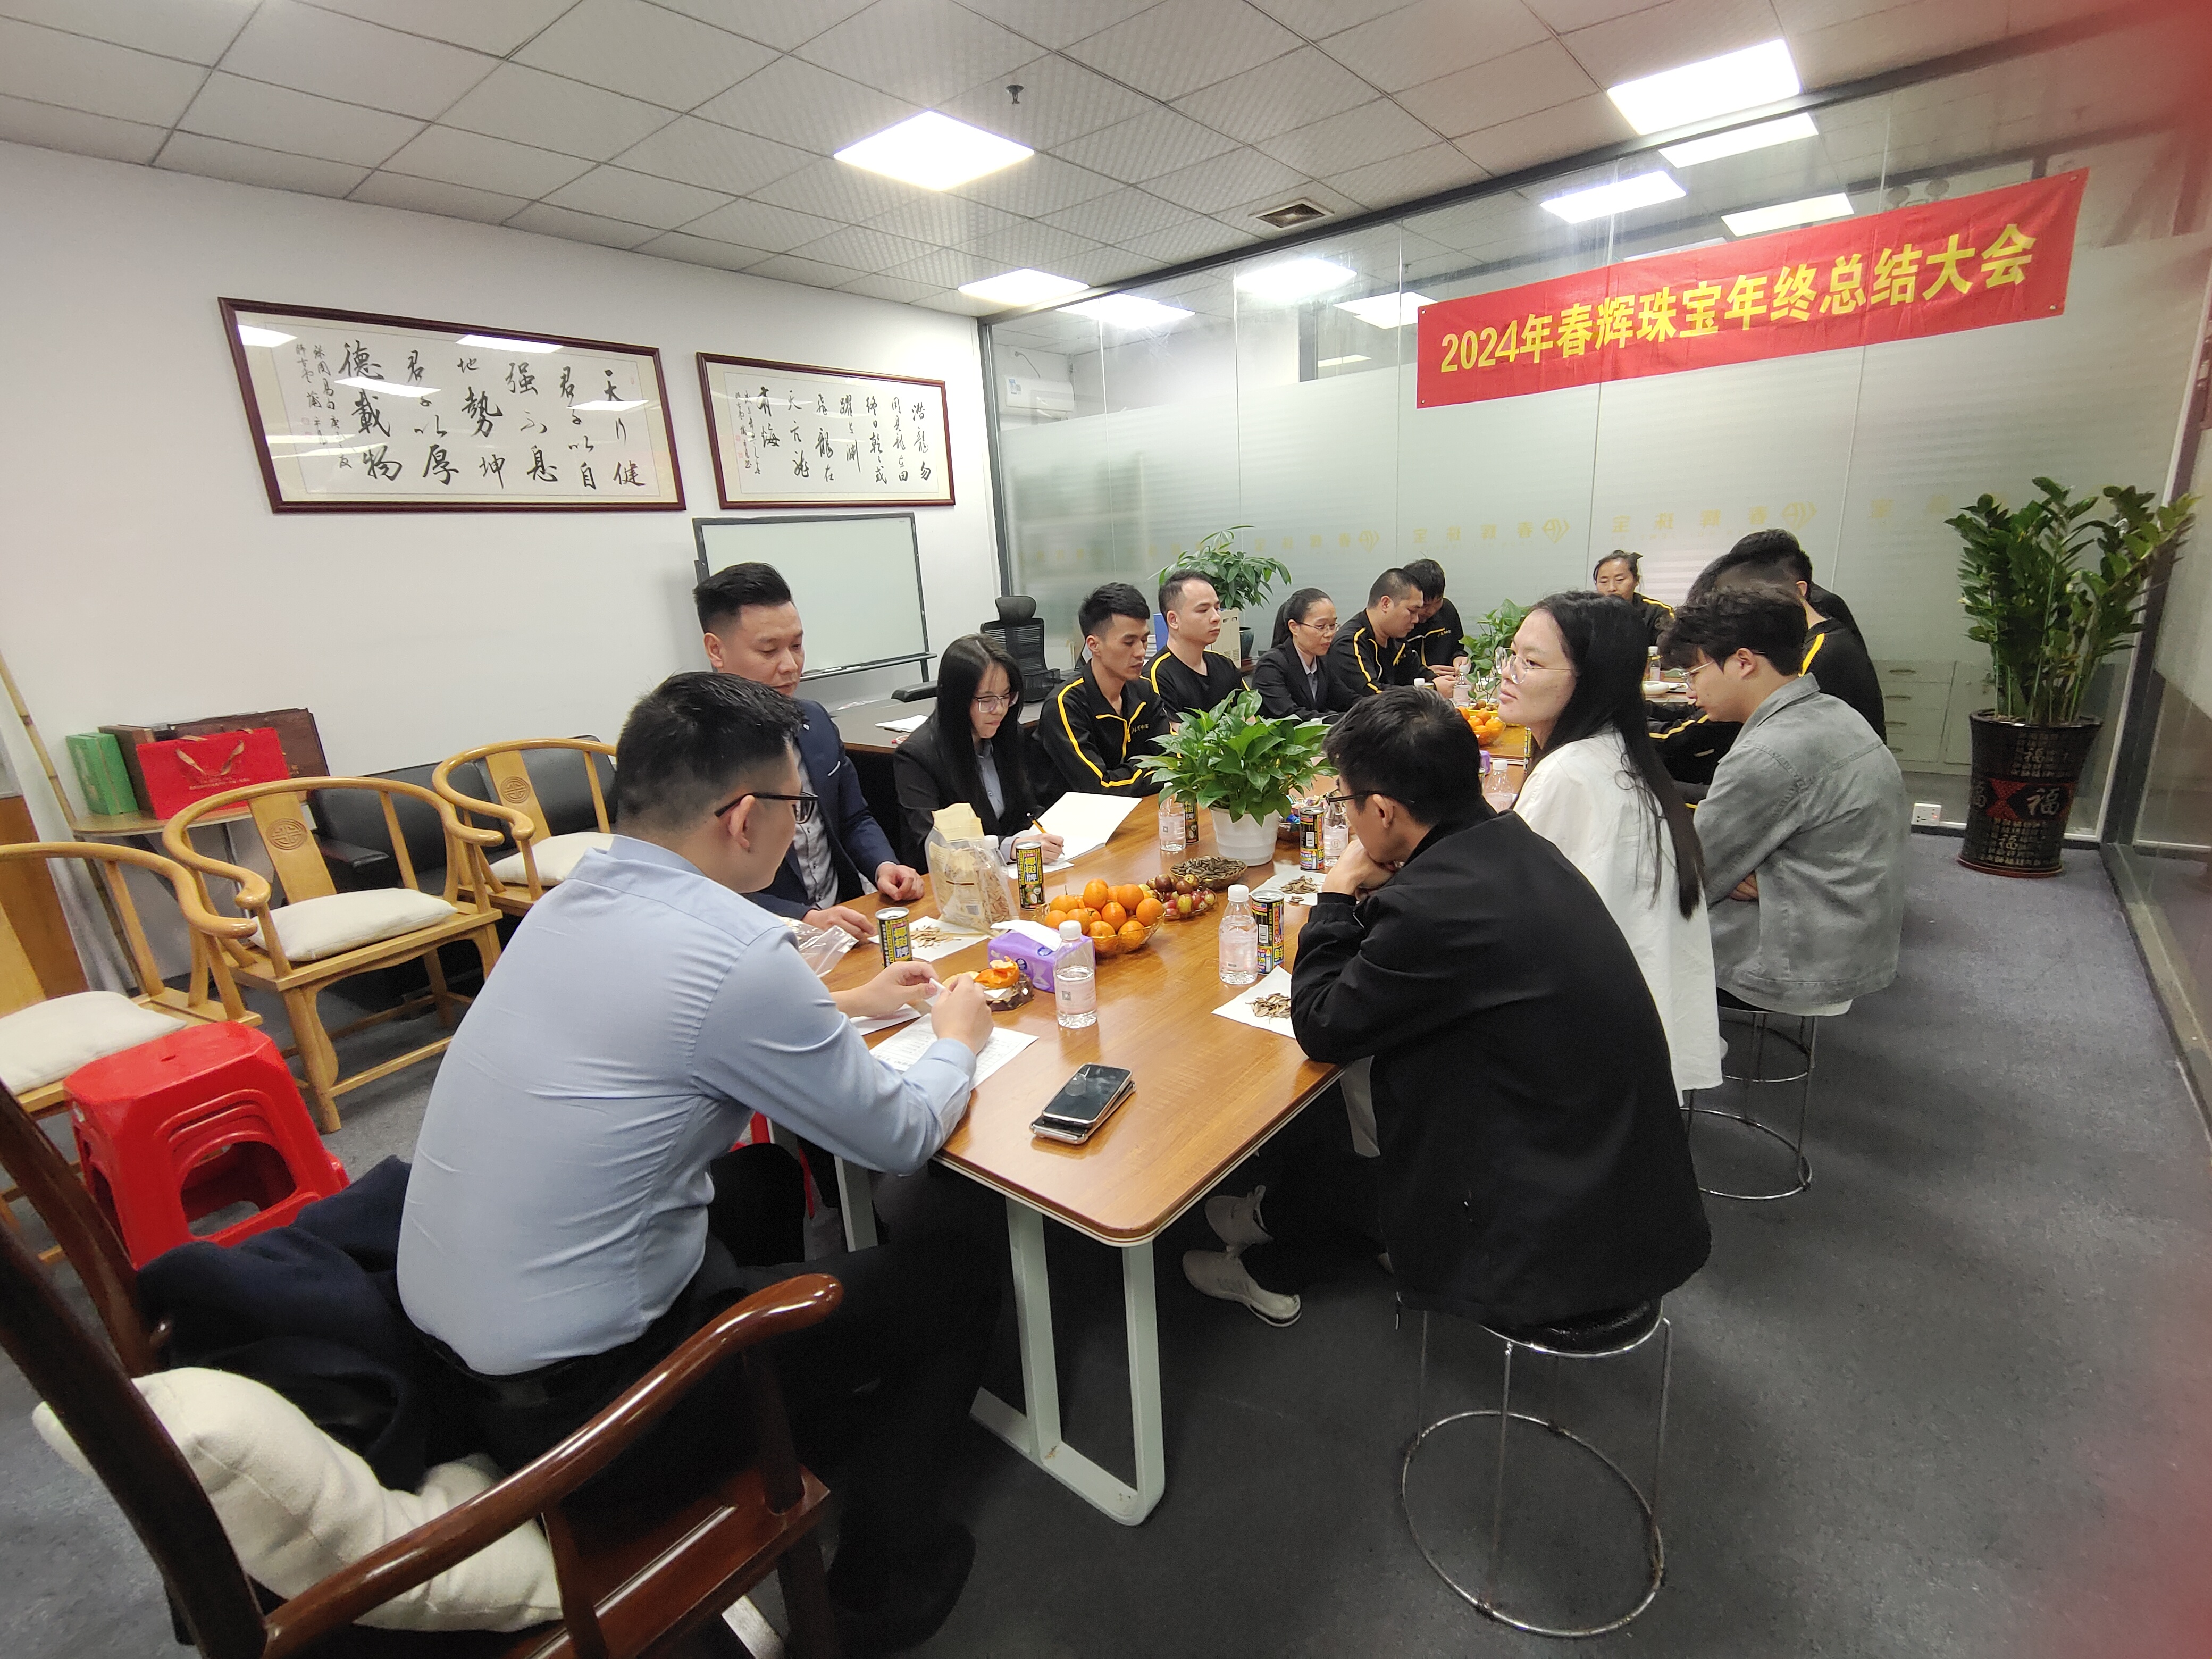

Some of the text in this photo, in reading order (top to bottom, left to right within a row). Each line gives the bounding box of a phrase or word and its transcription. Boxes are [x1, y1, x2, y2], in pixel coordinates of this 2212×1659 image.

[1440, 223, 2035, 373] 2024年春辉珠宝年终总结大会
[2026, 787, 2060, 816] 福
